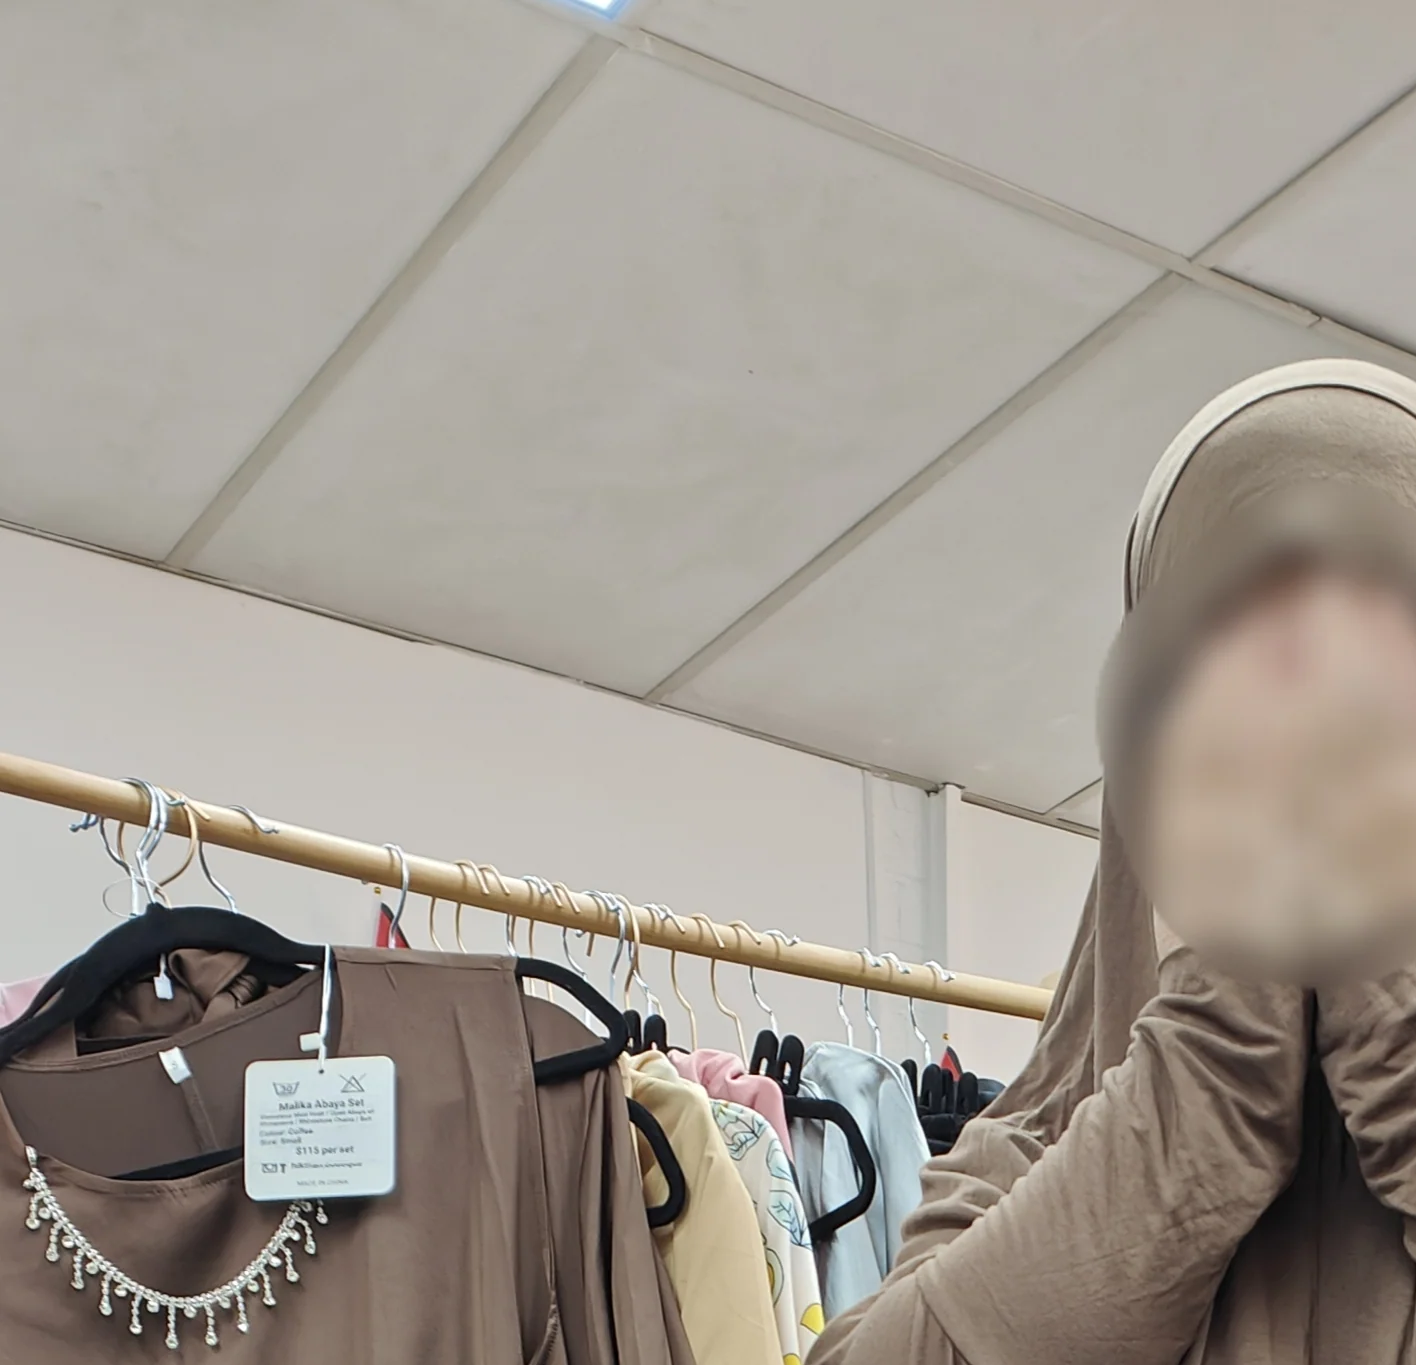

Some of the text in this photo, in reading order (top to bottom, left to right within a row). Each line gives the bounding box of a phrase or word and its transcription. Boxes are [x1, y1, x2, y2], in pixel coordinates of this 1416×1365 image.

[279, 1098, 365, 1111] Malika Abaya Set
[322, 1146, 338, 1156] per
[339, 1145, 355, 1154] set
